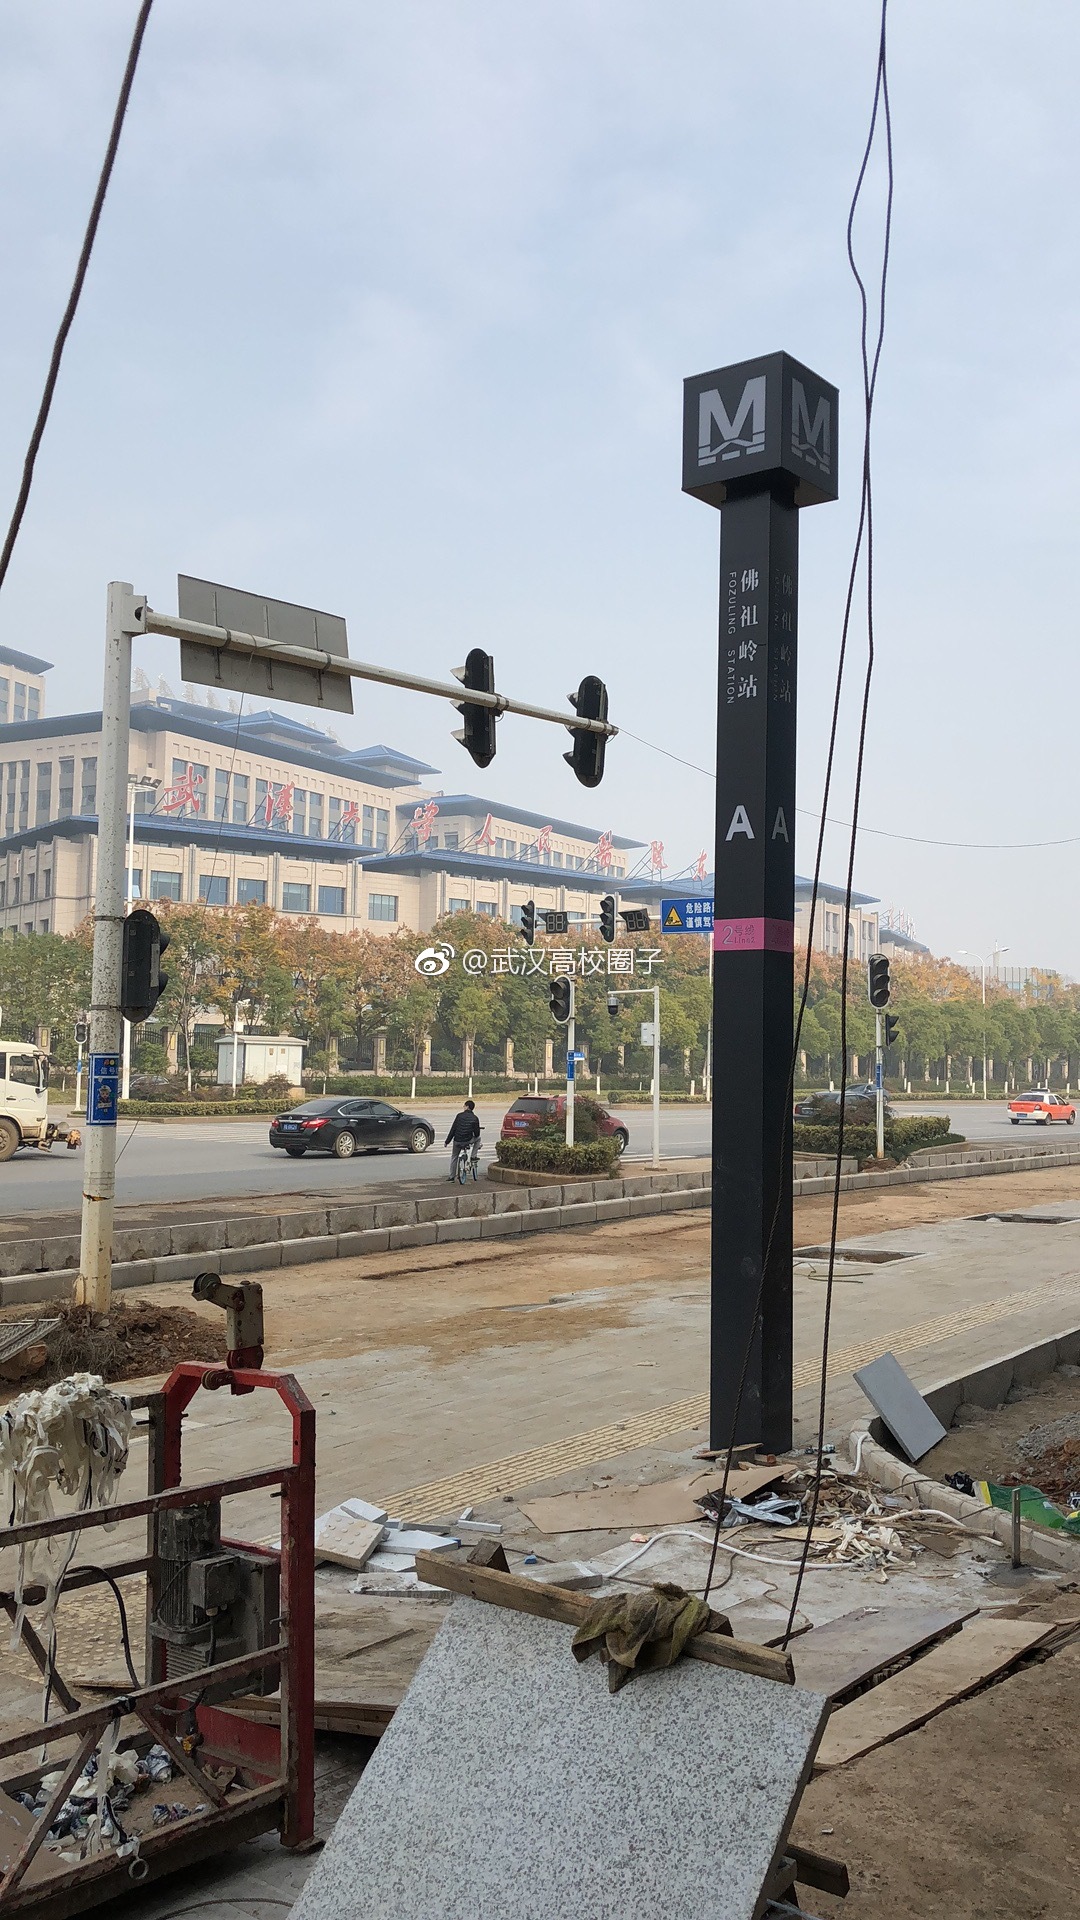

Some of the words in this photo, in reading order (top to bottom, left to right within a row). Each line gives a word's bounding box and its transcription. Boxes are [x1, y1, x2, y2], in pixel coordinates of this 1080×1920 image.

[727, 571, 737, 636] FOZULING
[736, 568, 759, 700] 佛祖岭站
[726, 650, 736, 705] STATION
[725, 805, 755, 841] A
[771, 806, 789, 843] A
[685, 902, 714, 914] 危险路
[685, 917, 714, 929] 谨慎驾
